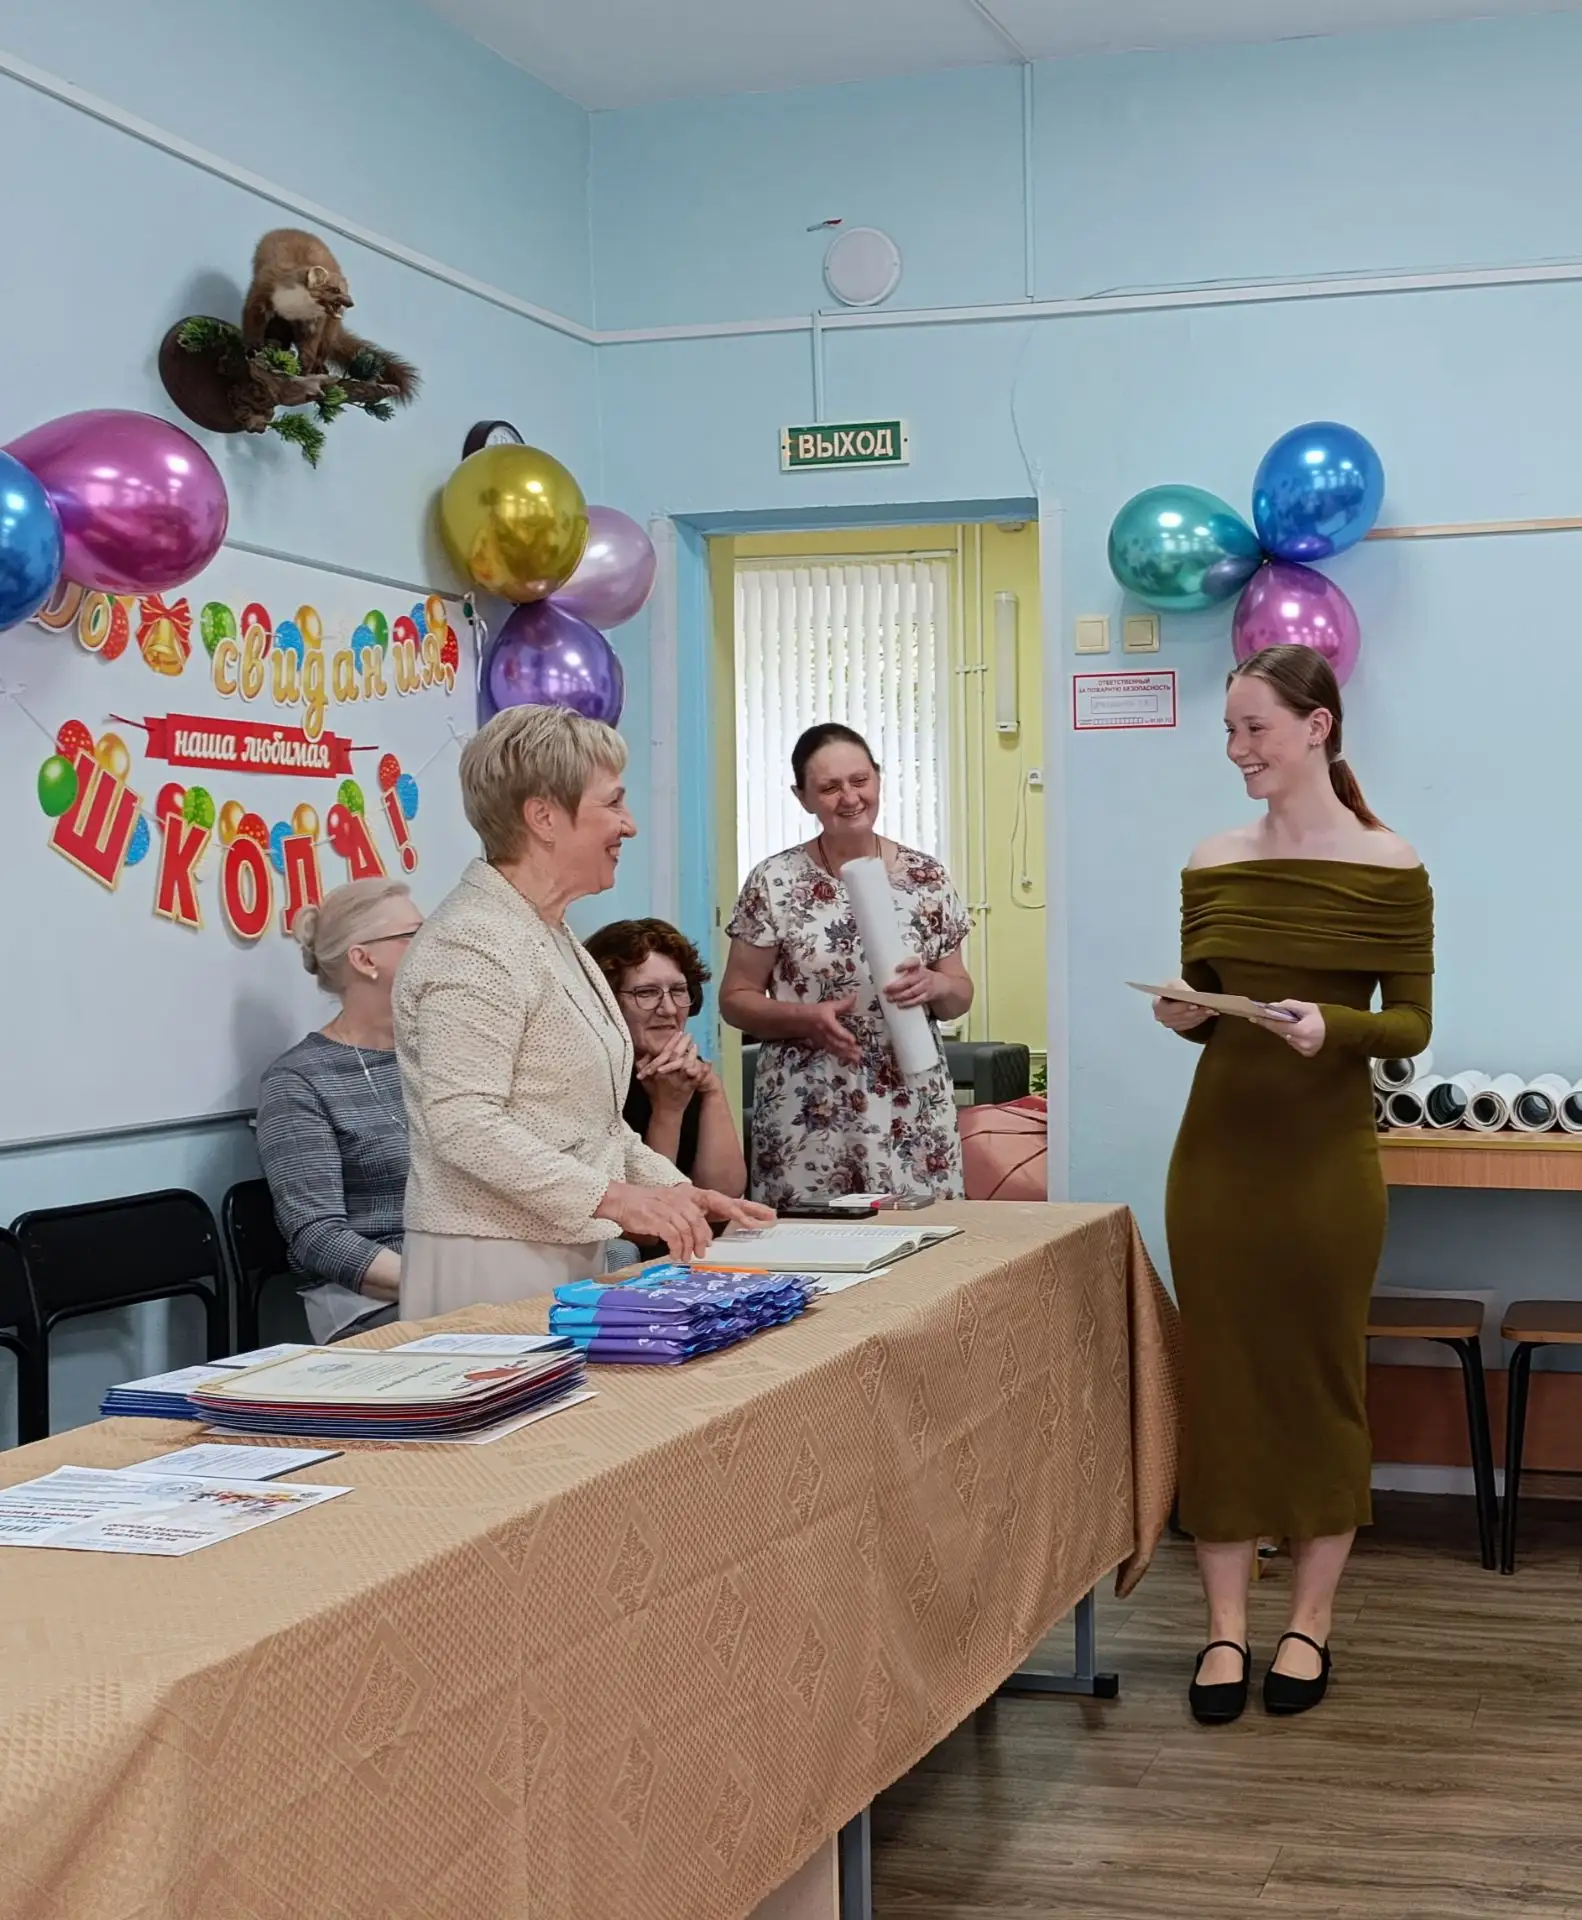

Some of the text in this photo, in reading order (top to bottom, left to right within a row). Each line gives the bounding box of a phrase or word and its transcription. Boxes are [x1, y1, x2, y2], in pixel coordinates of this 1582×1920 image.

[798, 429, 894, 459] ВЫХОД
[212, 623, 457, 743] свидания,
[174, 730, 331, 769] наша любимая
